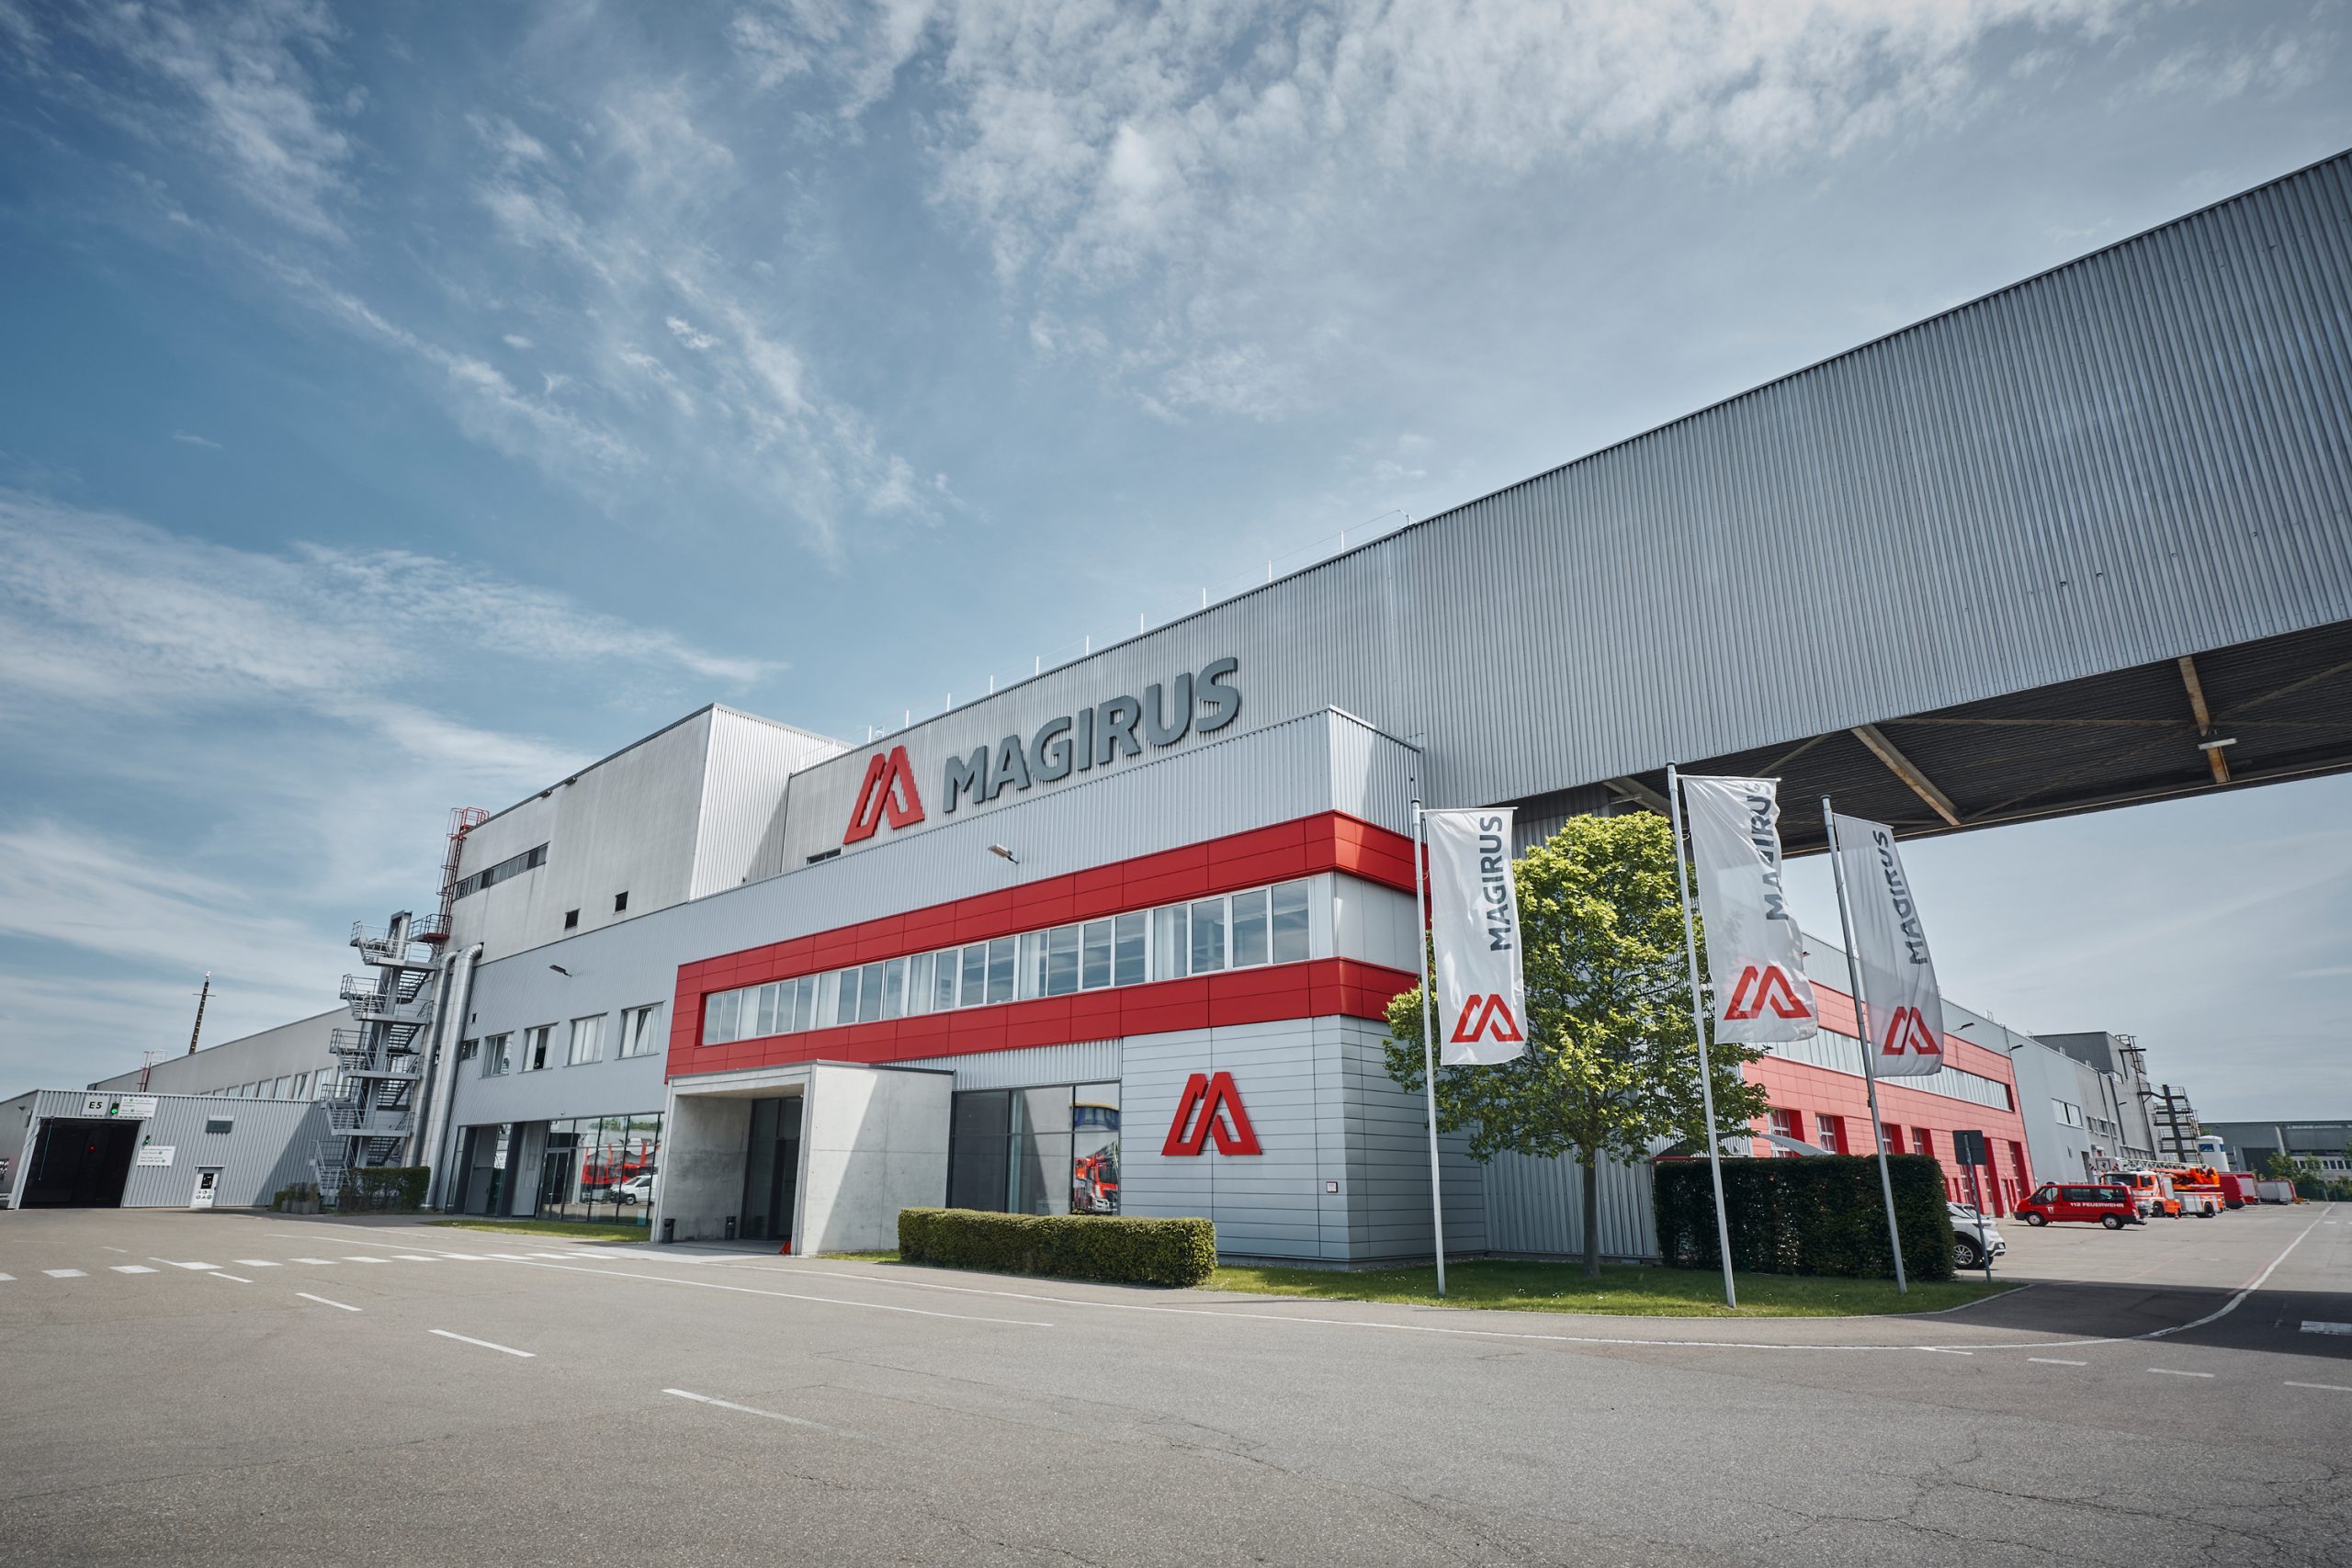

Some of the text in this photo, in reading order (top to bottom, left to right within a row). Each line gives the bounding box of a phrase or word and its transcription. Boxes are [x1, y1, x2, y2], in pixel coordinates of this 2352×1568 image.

[943, 656, 1241, 813] MAGIRUS
[1479, 816, 1513, 952] MAGIRUS
[1872, 830, 1928, 965] MAGIRUS
